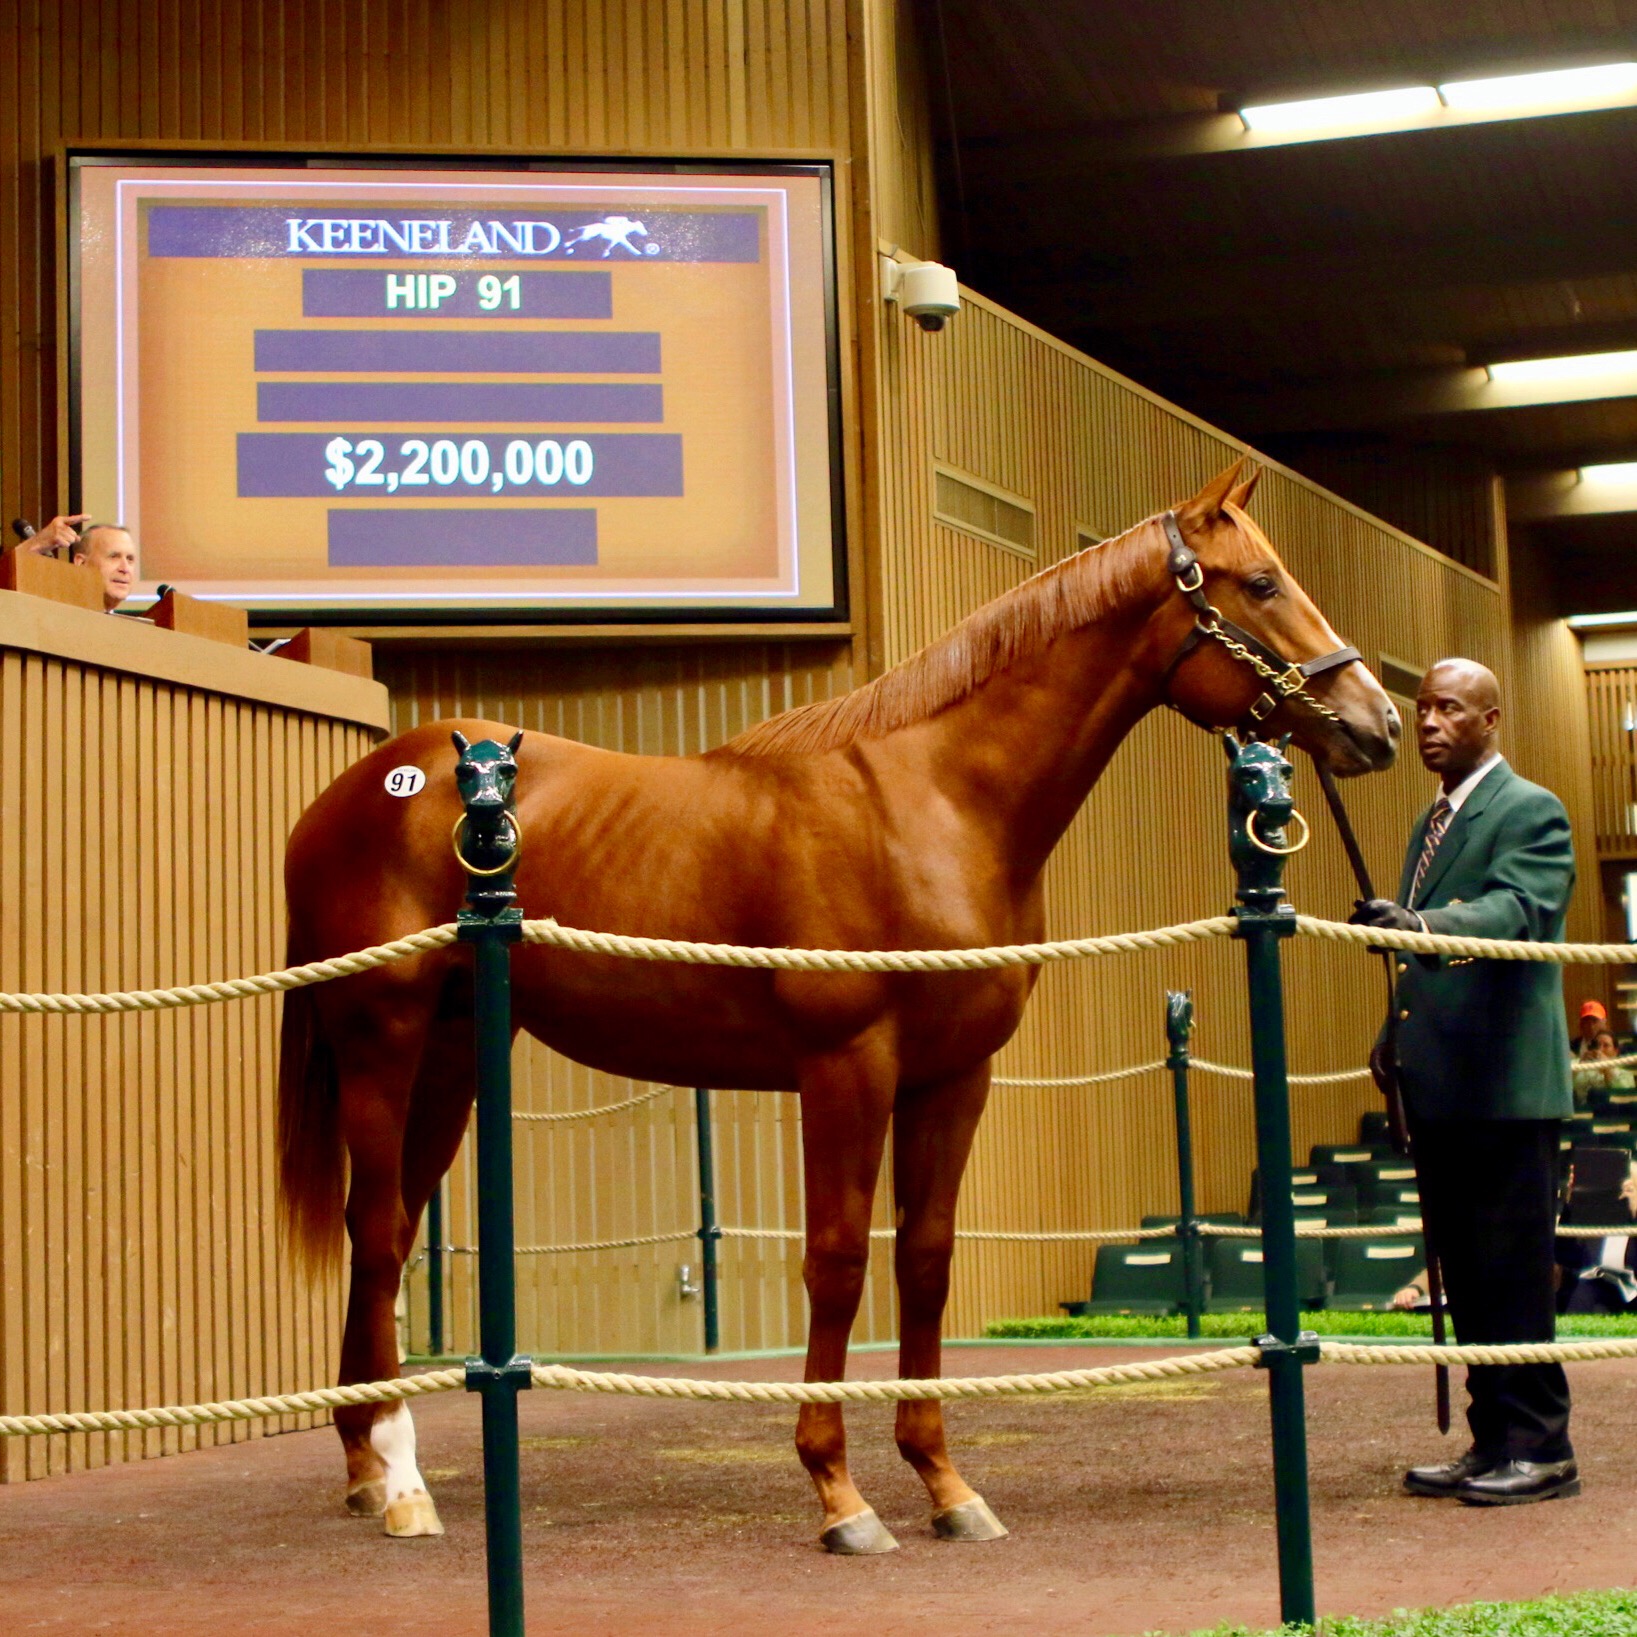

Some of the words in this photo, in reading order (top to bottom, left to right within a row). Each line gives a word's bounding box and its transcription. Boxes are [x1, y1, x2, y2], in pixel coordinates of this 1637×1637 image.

[286, 218, 561, 254] KEENELAND
[385, 274, 457, 309] HIP
[477, 275, 521, 309] 91
[324, 436, 594, 493] $2,200,000
[390, 772, 417, 792] 91
